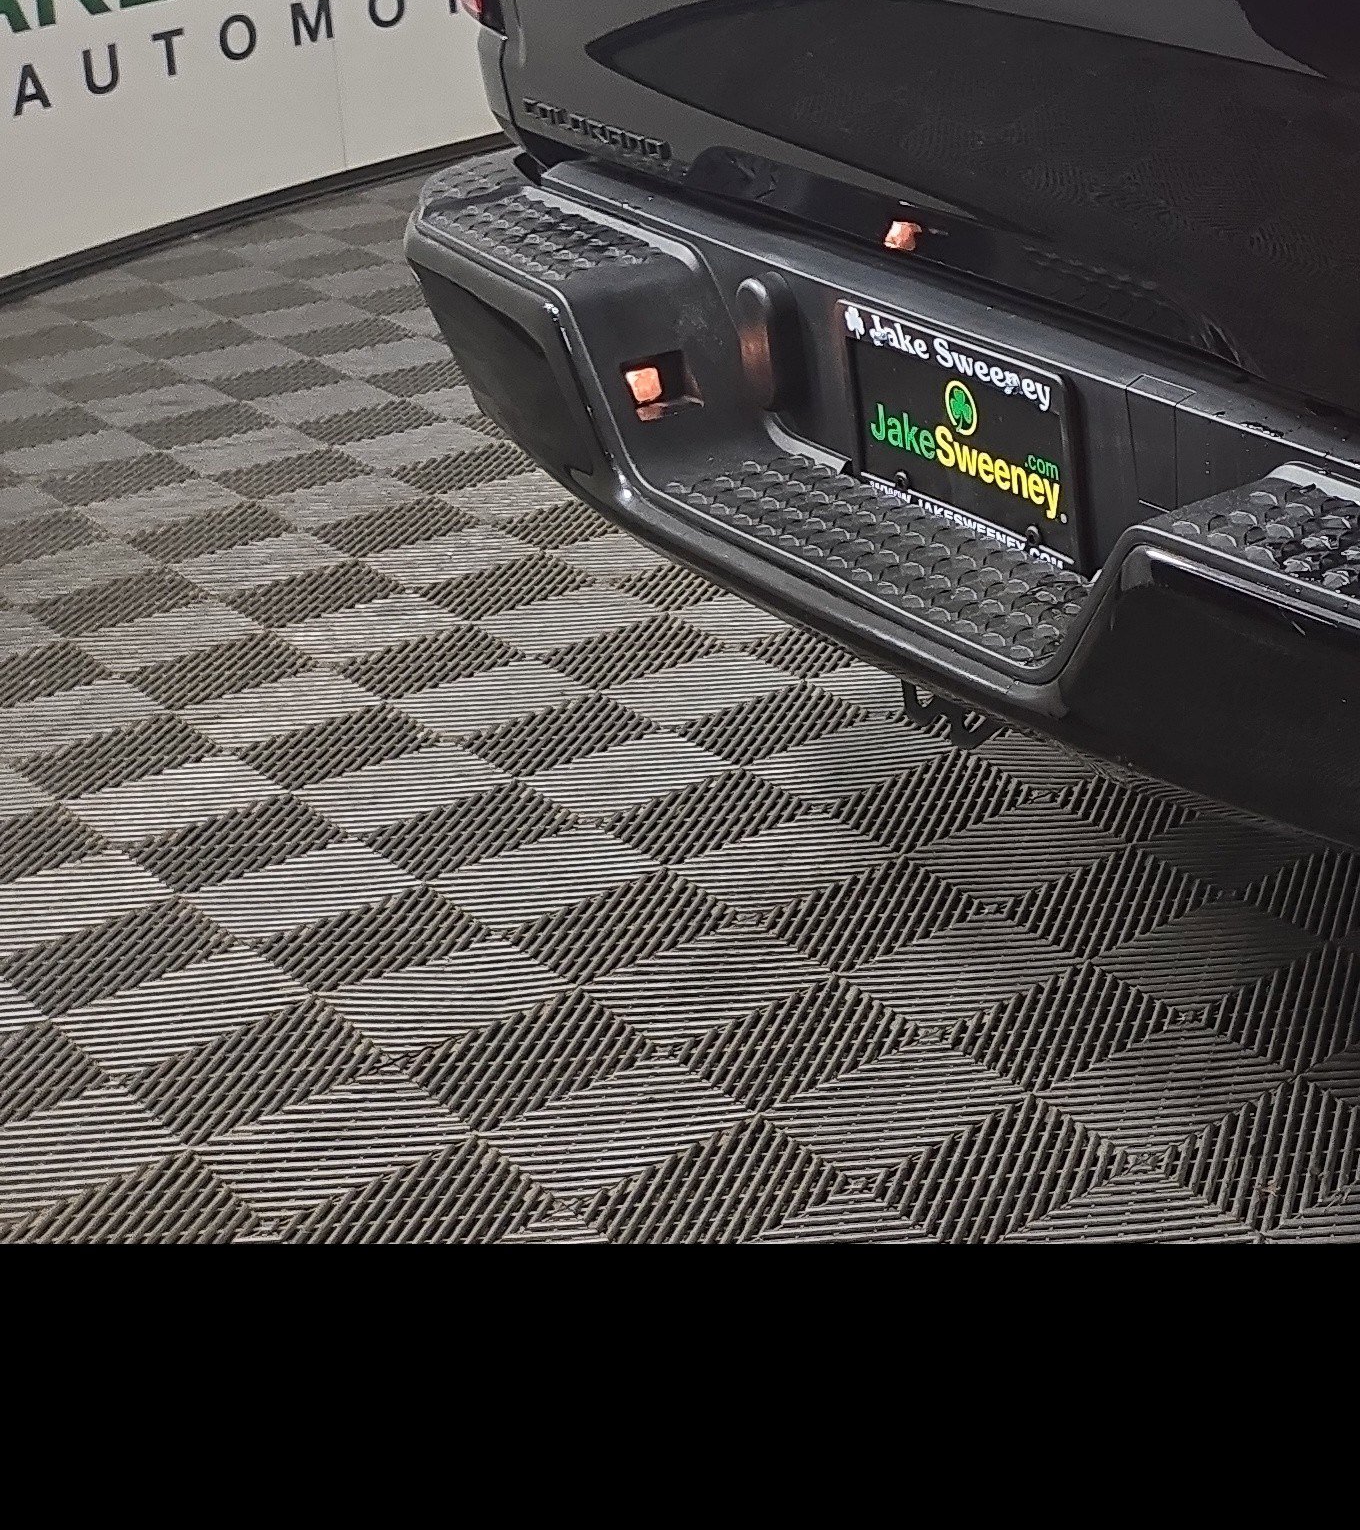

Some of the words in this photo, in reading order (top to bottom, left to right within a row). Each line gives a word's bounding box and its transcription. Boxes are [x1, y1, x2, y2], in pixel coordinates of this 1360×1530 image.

[869, 314, 931, 360] Jake
[932, 336, 1051, 412] Sweeney
[1023, 454, 1060, 481] .com
